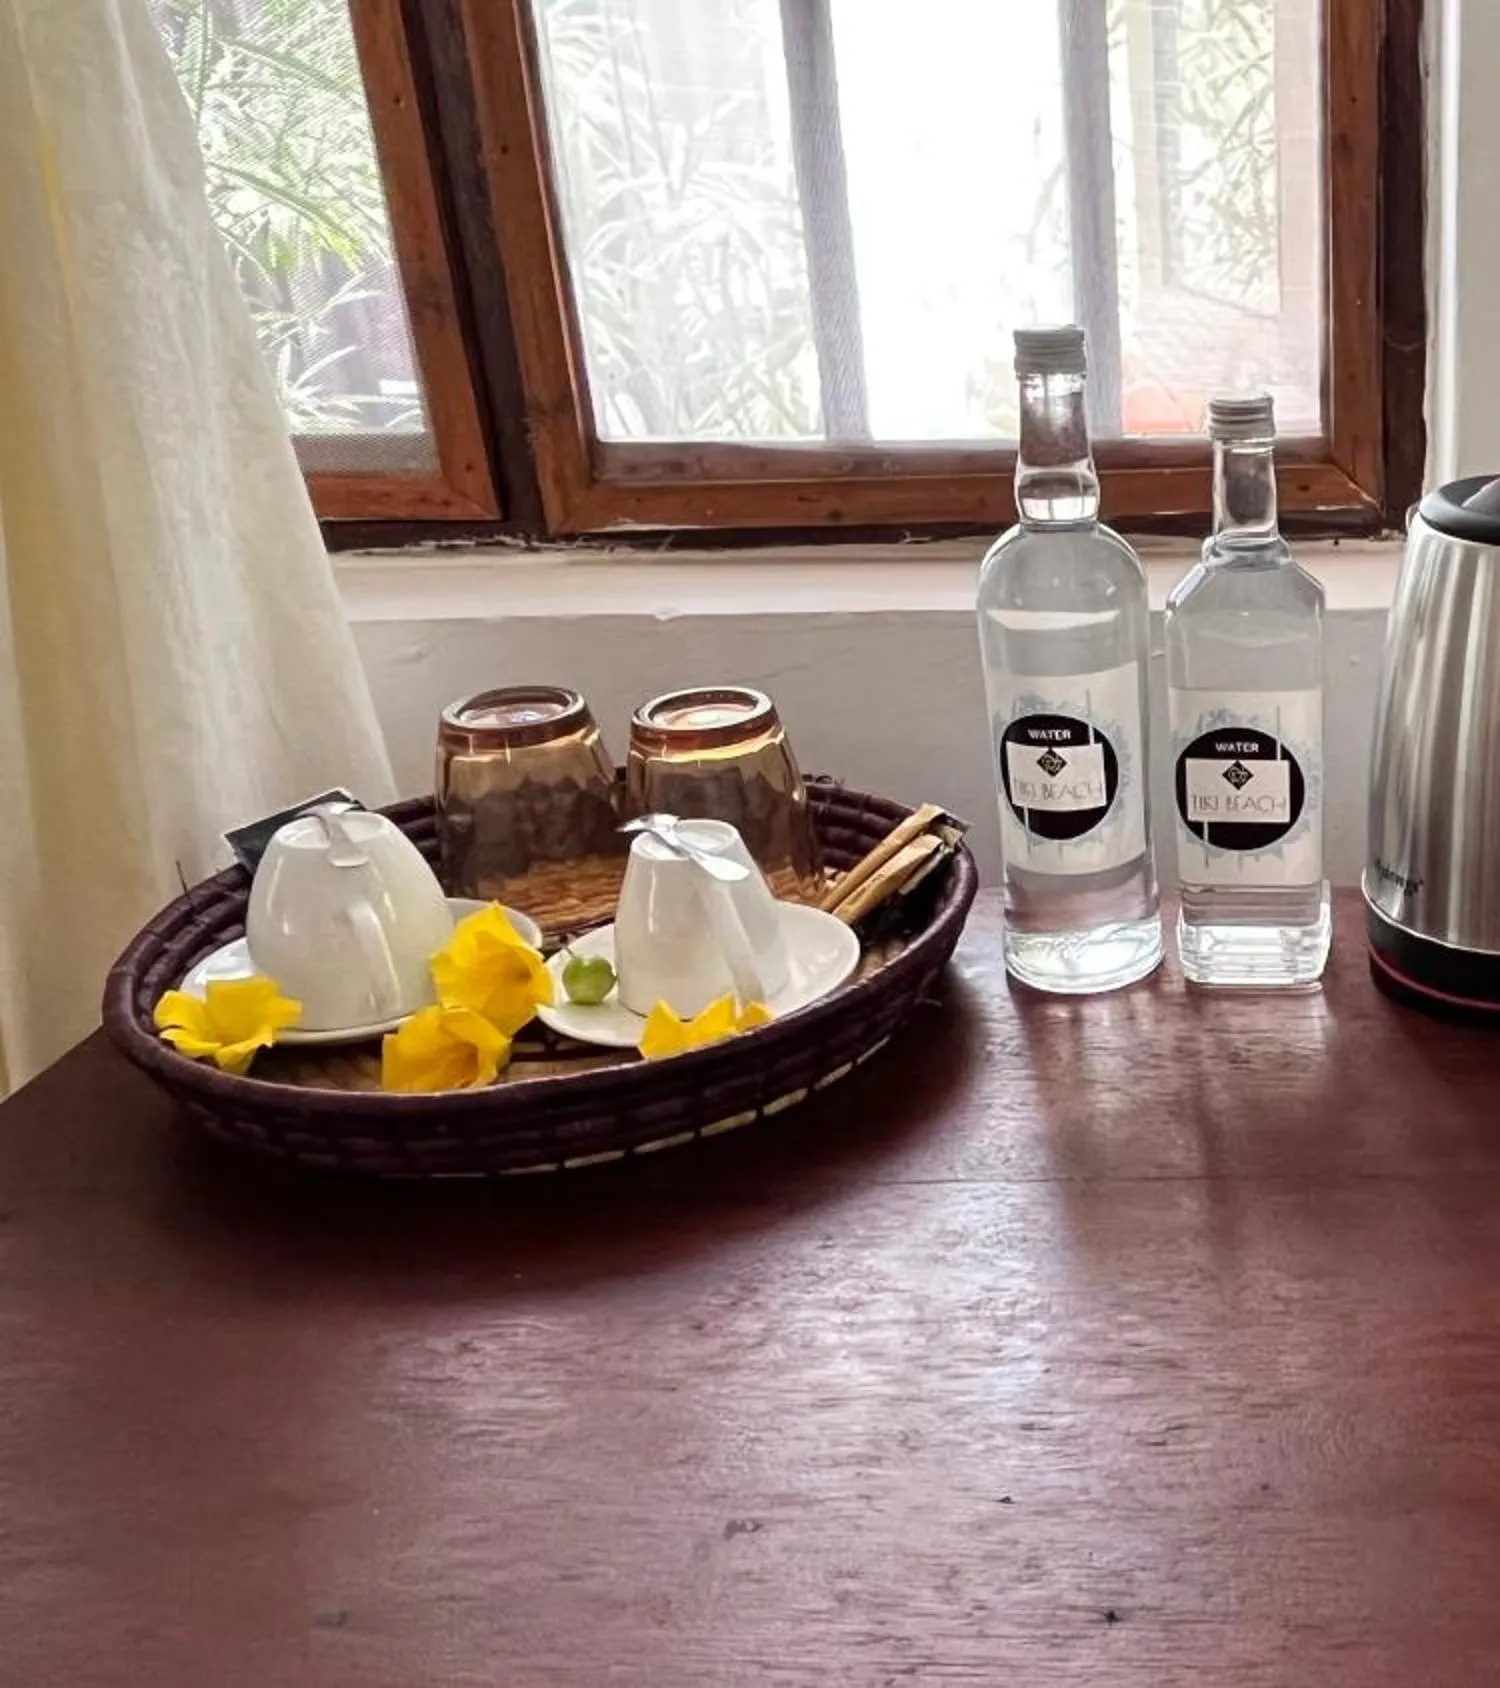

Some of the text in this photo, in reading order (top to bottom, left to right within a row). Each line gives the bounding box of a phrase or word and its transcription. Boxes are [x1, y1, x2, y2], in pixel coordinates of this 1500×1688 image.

[1027, 728, 1072, 741] WATER
[1215, 742, 1260, 753] WATER
[1042, 780, 1104, 801] BEACH
[1191, 794, 1287, 813] TIKI BEACH
